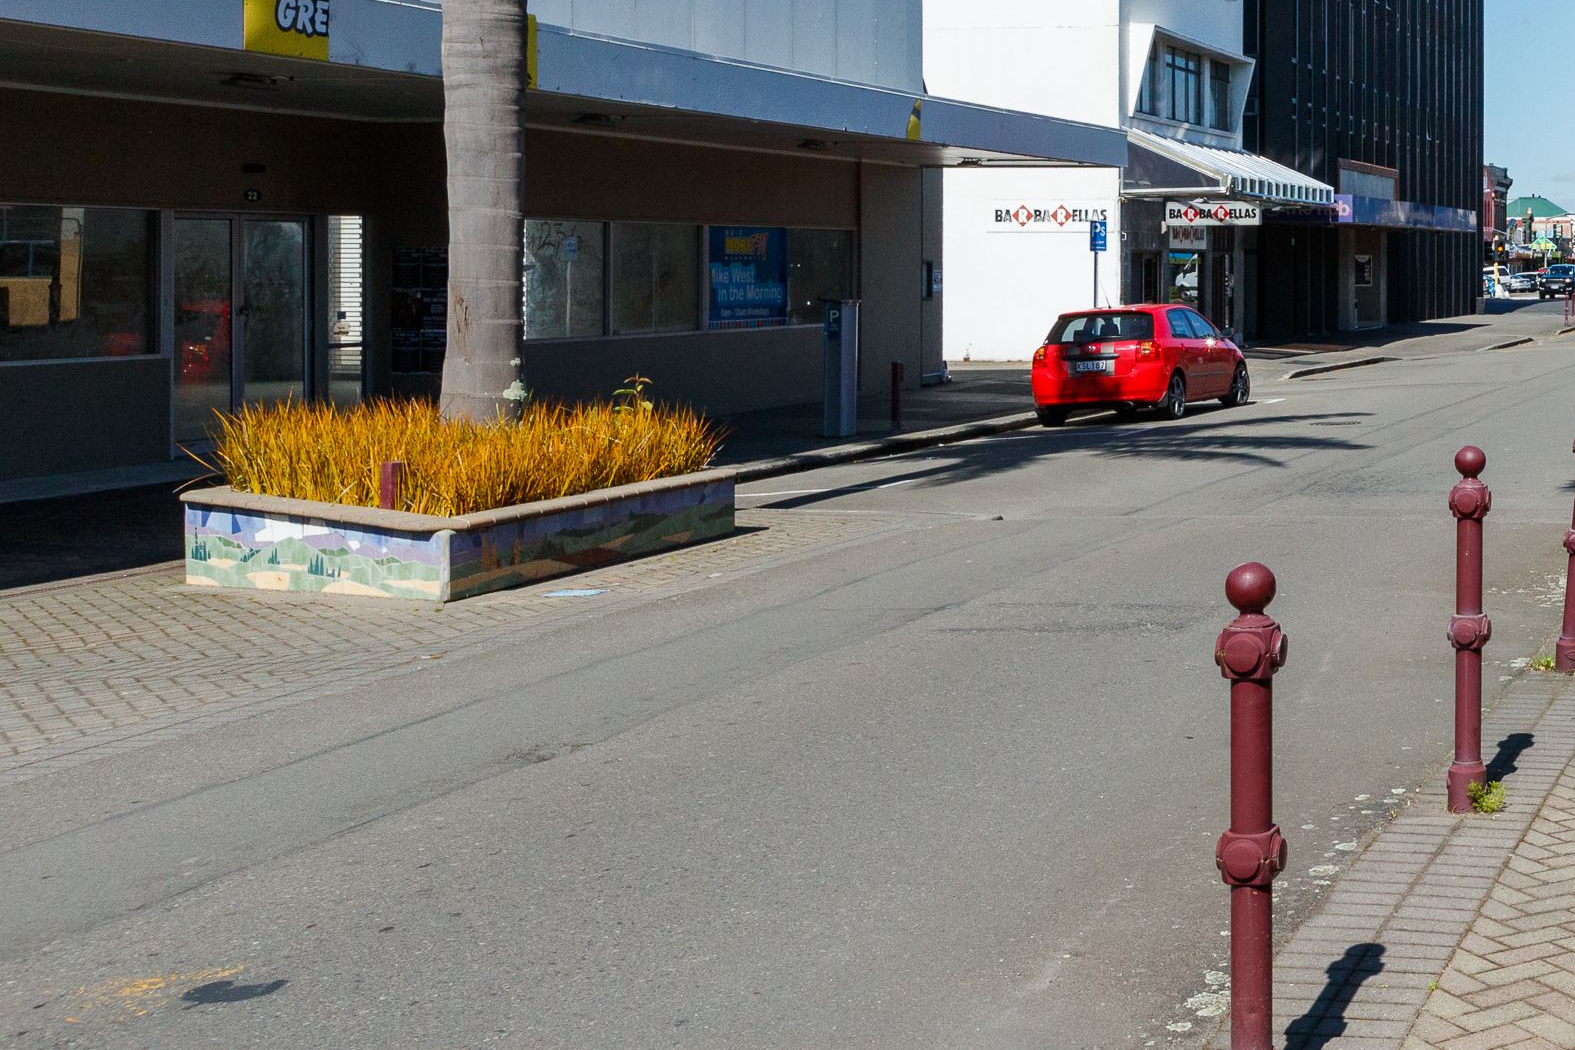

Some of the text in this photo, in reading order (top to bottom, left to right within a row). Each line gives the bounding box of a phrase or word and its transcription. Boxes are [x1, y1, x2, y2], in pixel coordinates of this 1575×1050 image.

[247, 190, 258, 200] 22
[995, 206, 1107, 225] BARBARELLAS
[1168, 207, 1257, 221] BARBARELLAS
[732, 267, 755, 283] West
[718, 284, 783, 303] in the Morning
[830, 310, 839, 323] P
